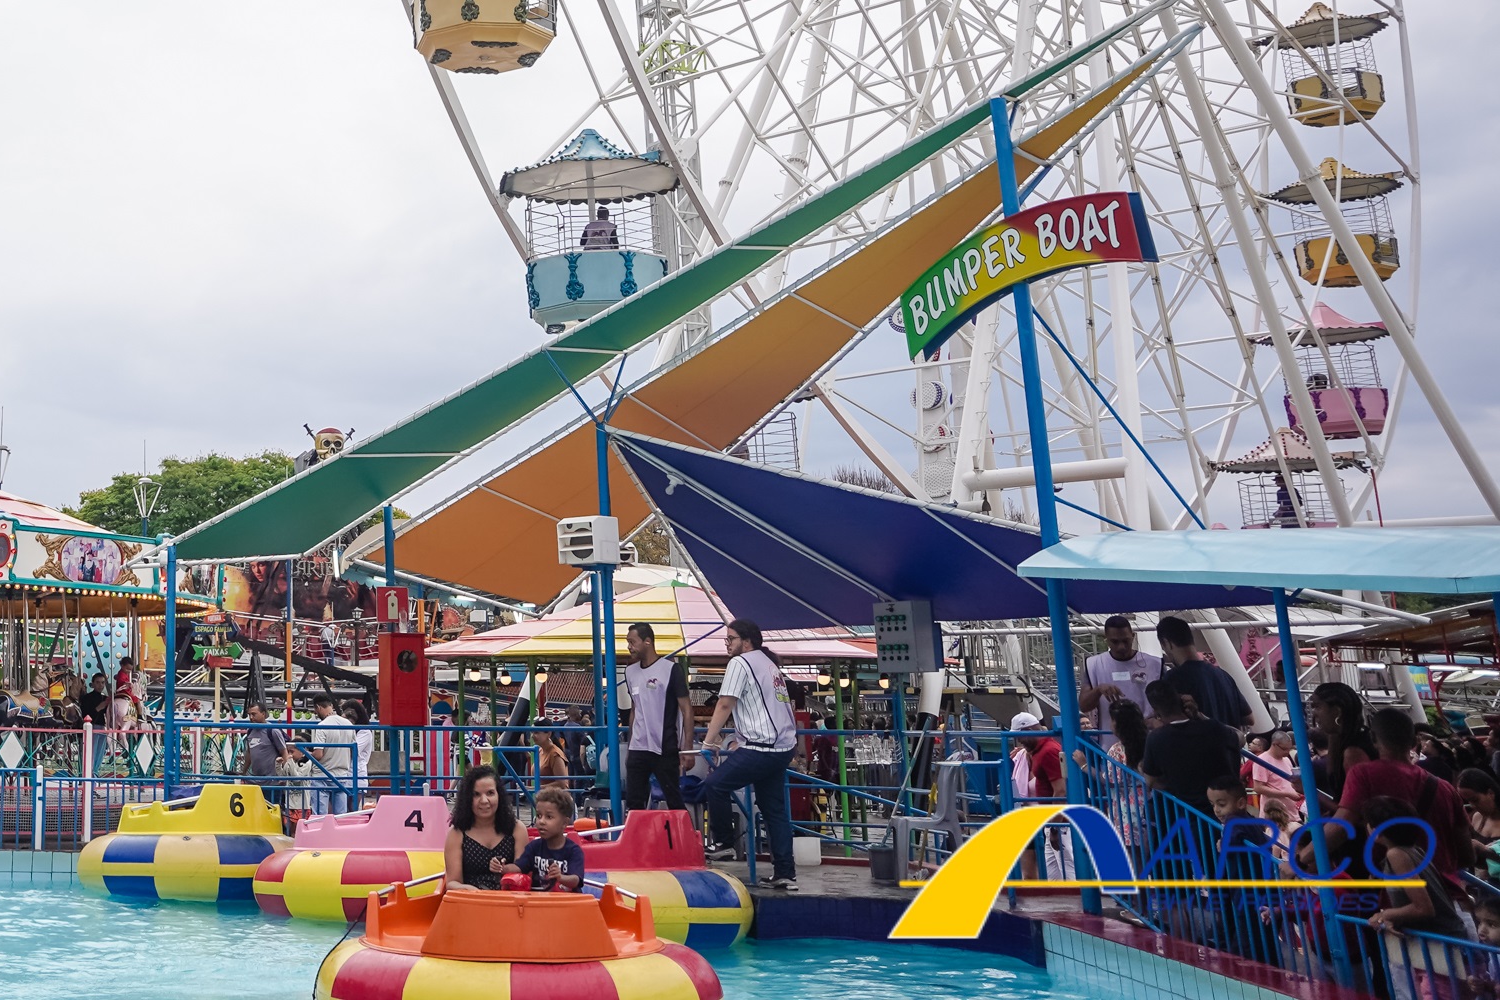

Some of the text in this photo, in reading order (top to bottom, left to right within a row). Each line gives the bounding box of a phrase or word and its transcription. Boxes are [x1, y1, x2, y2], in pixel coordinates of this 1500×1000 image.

[908, 200, 1121, 336] BUMPER BOAT
[202, 648, 229, 657] CAIXAS
[229, 792, 245, 818] 6
[404, 809, 425, 832] 4
[663, 819, 673, 850] 1
